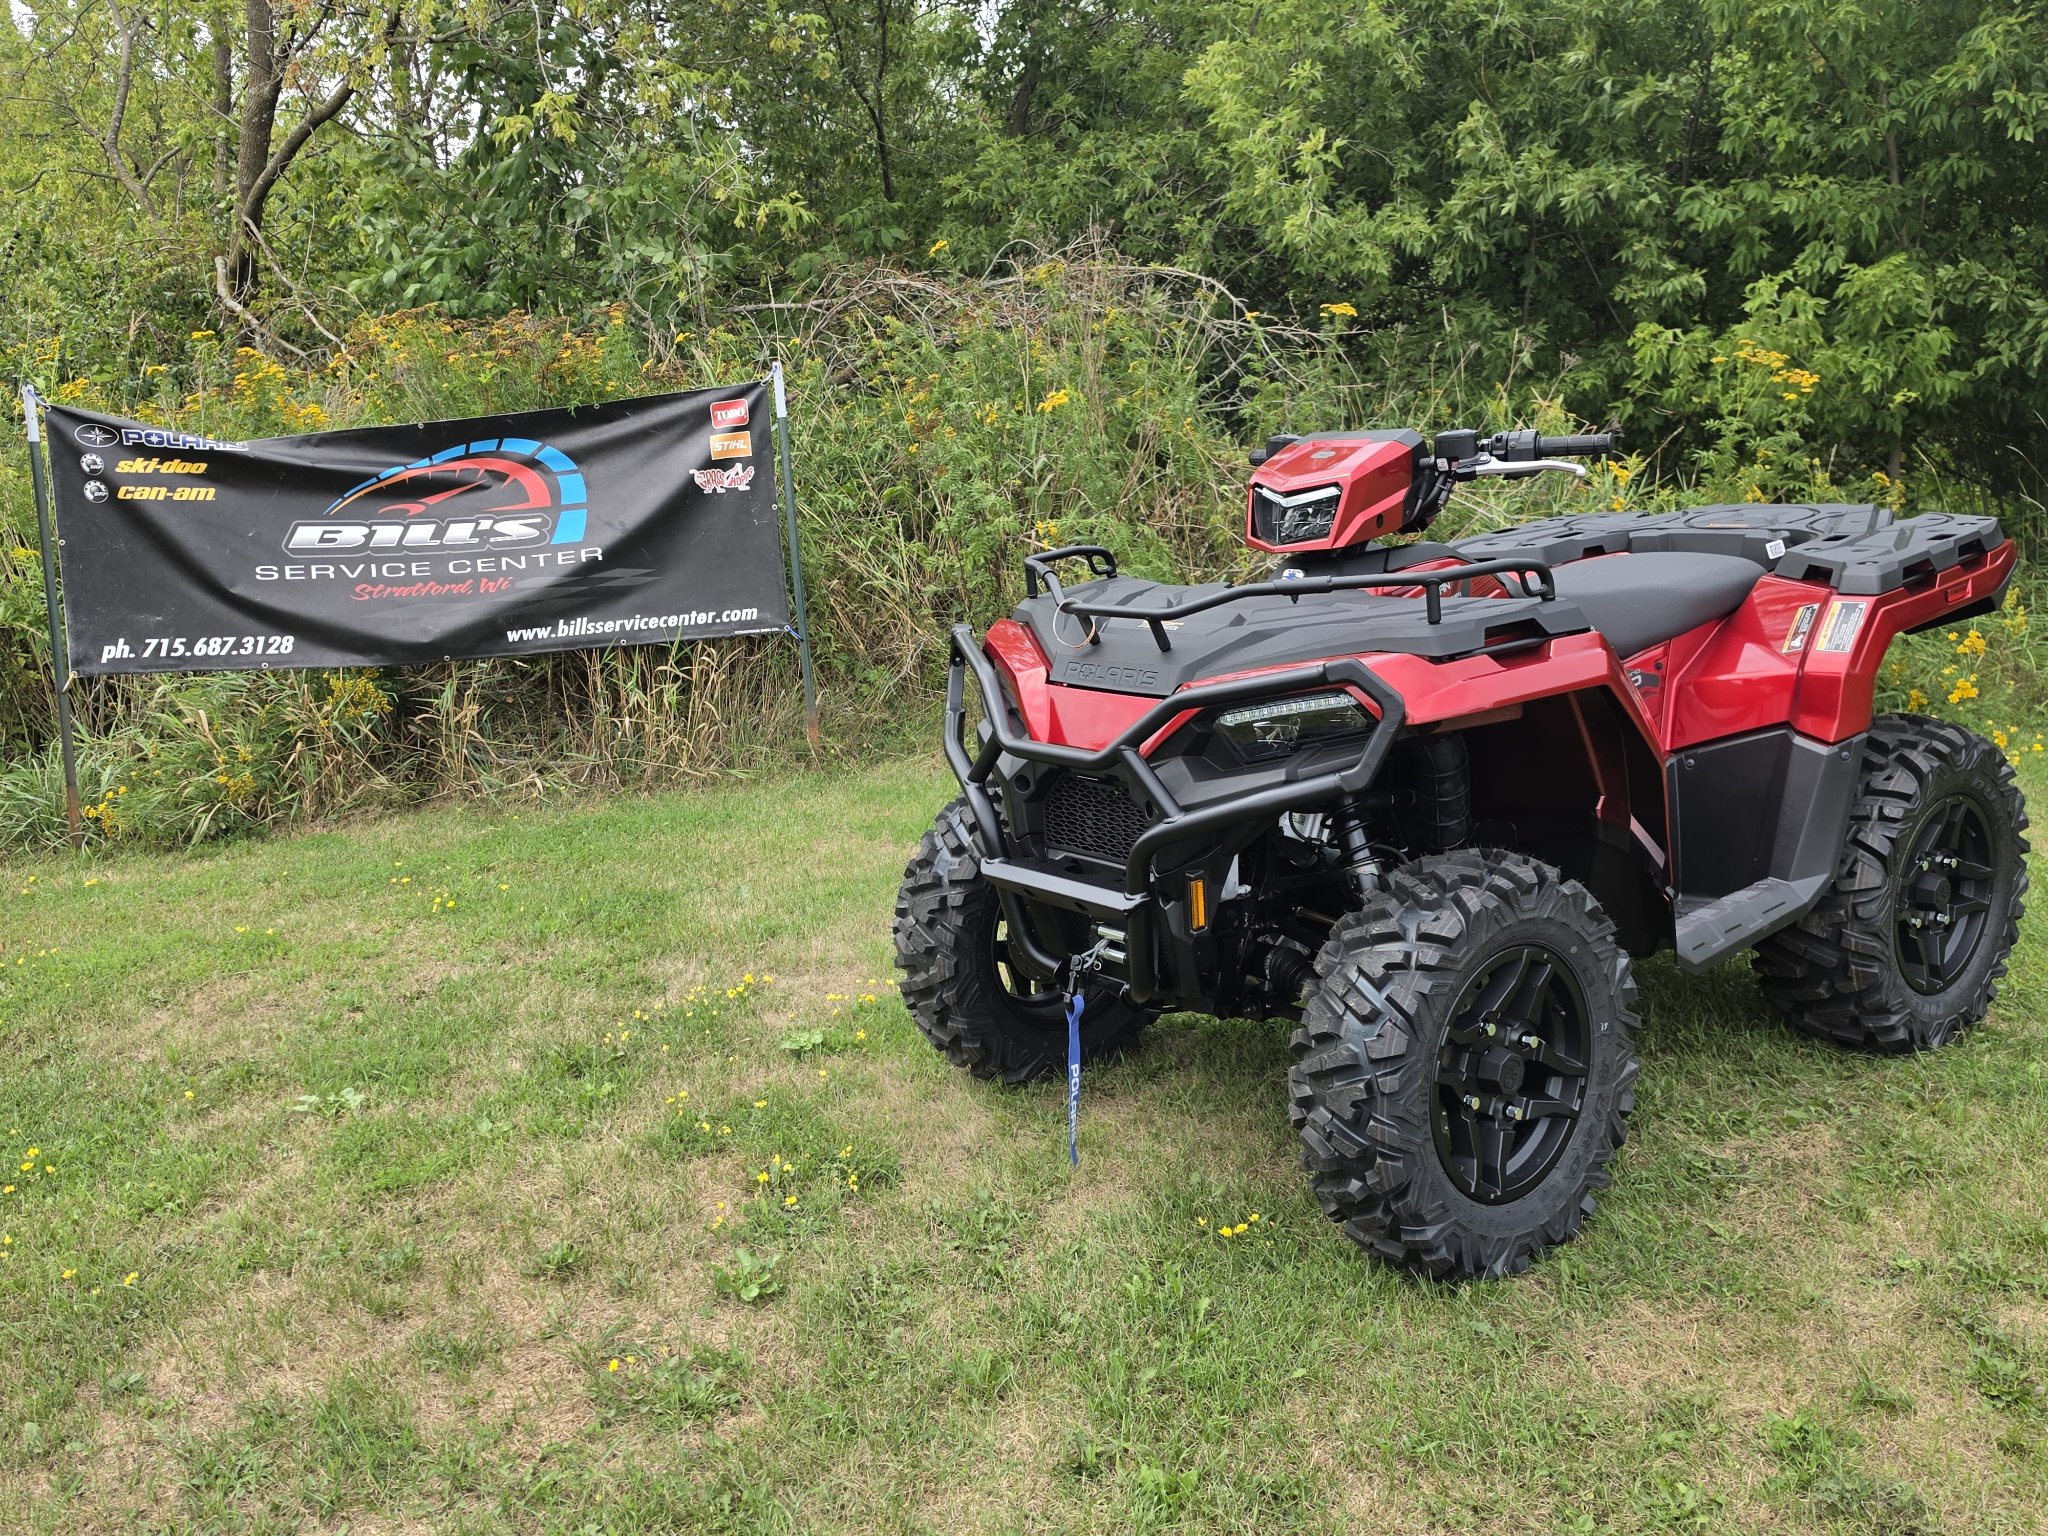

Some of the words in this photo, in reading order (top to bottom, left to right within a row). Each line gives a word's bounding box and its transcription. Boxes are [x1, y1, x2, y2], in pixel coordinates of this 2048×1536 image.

[714, 407, 746, 421] TORO
[714, 439, 748, 452] STIHL
[115, 457, 208, 474] ski-doo
[117, 485, 216, 501] can-am
[255, 561, 431, 581] SERVICE
[448, 547, 604, 575] CENTER
[350, 578, 473, 601] Stratford,
[507, 607, 758, 643] www.billsservicecenter.com
[100, 638, 136, 664] ph.
[142, 635, 295, 658] 715.687.3128
[1065, 661, 1159, 688] POLARIS
